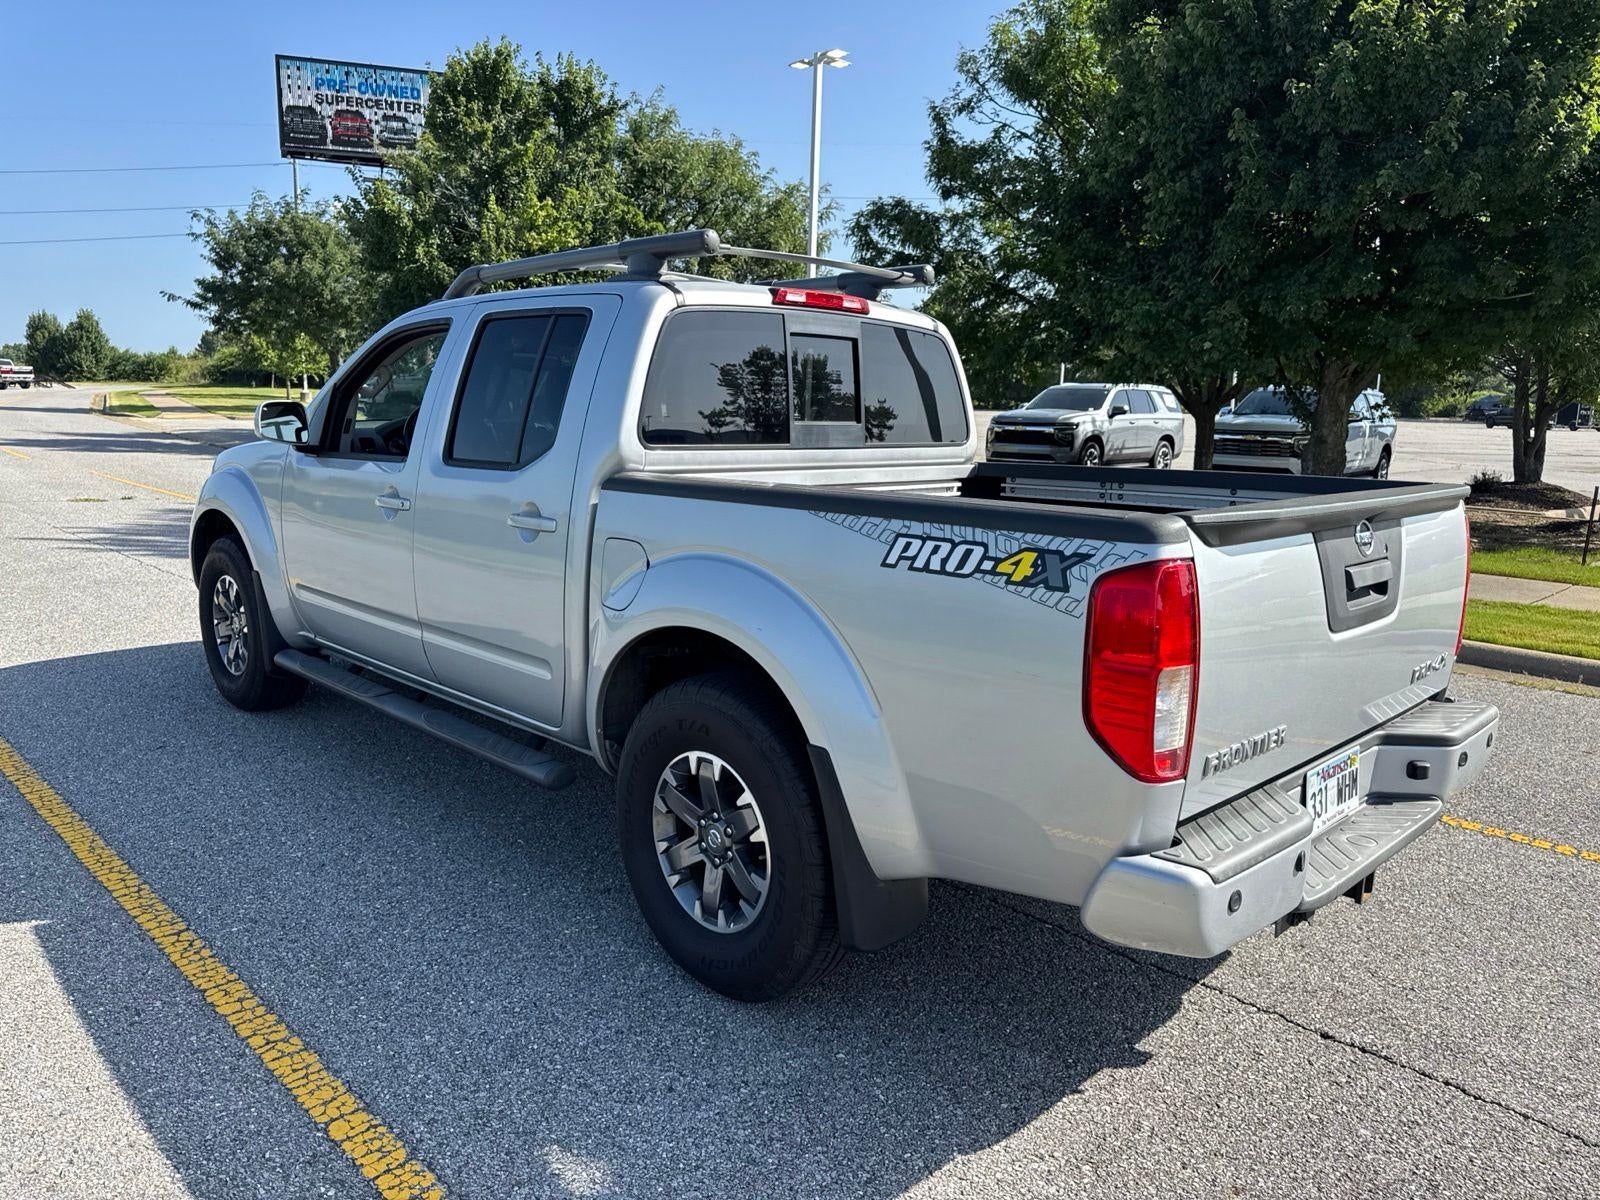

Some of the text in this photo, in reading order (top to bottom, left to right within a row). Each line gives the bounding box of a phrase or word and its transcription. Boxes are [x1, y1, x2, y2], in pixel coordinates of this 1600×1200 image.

[315, 77, 421, 100] PRE-OWNED
[315, 93, 422, 114] SUPERCENTER
[880, 533, 1096, 593] PRO-4X
[1201, 725, 1287, 780] FRONTIER
[1310, 784, 1328, 821] 331
[1336, 767, 1358, 807] WHM
